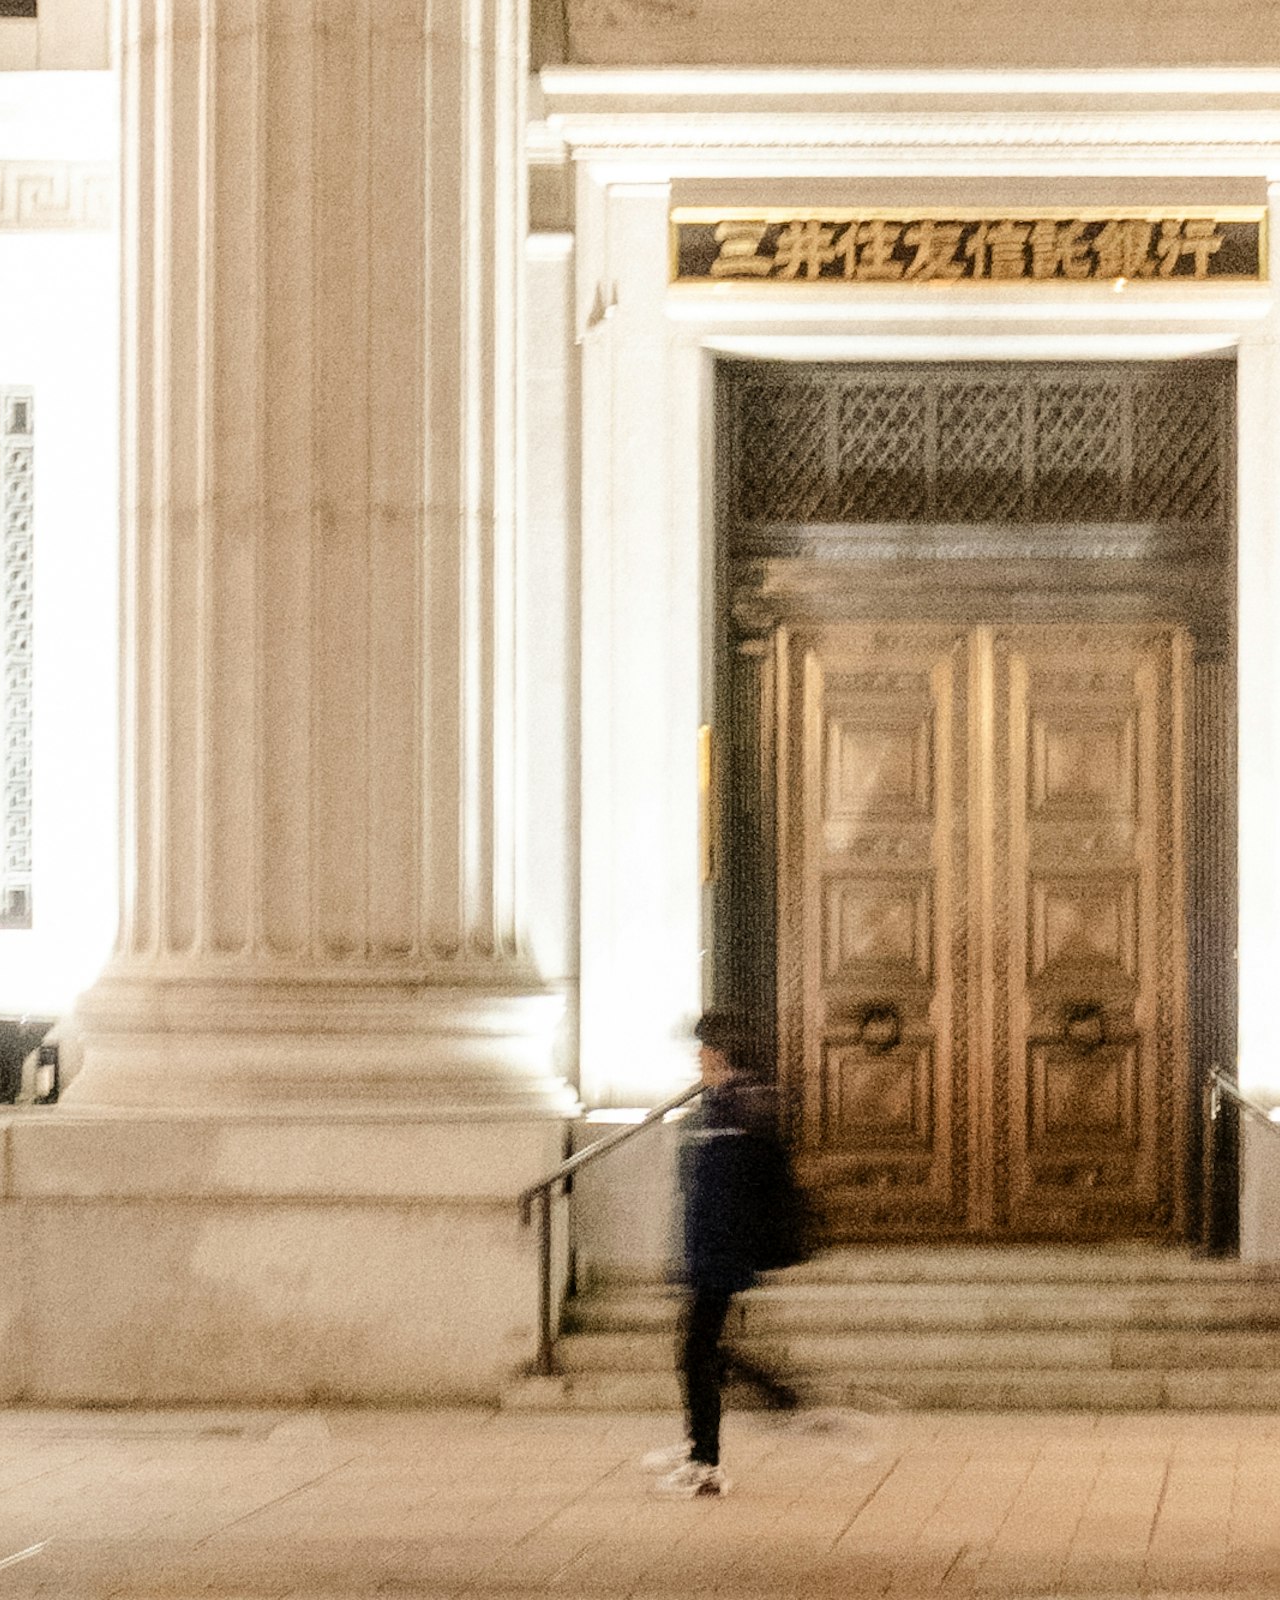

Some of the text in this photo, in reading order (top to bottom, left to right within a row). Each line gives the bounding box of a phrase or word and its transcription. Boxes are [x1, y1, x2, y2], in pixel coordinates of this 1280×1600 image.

[710, 220, 1221, 278] 三井住友信託銀行
